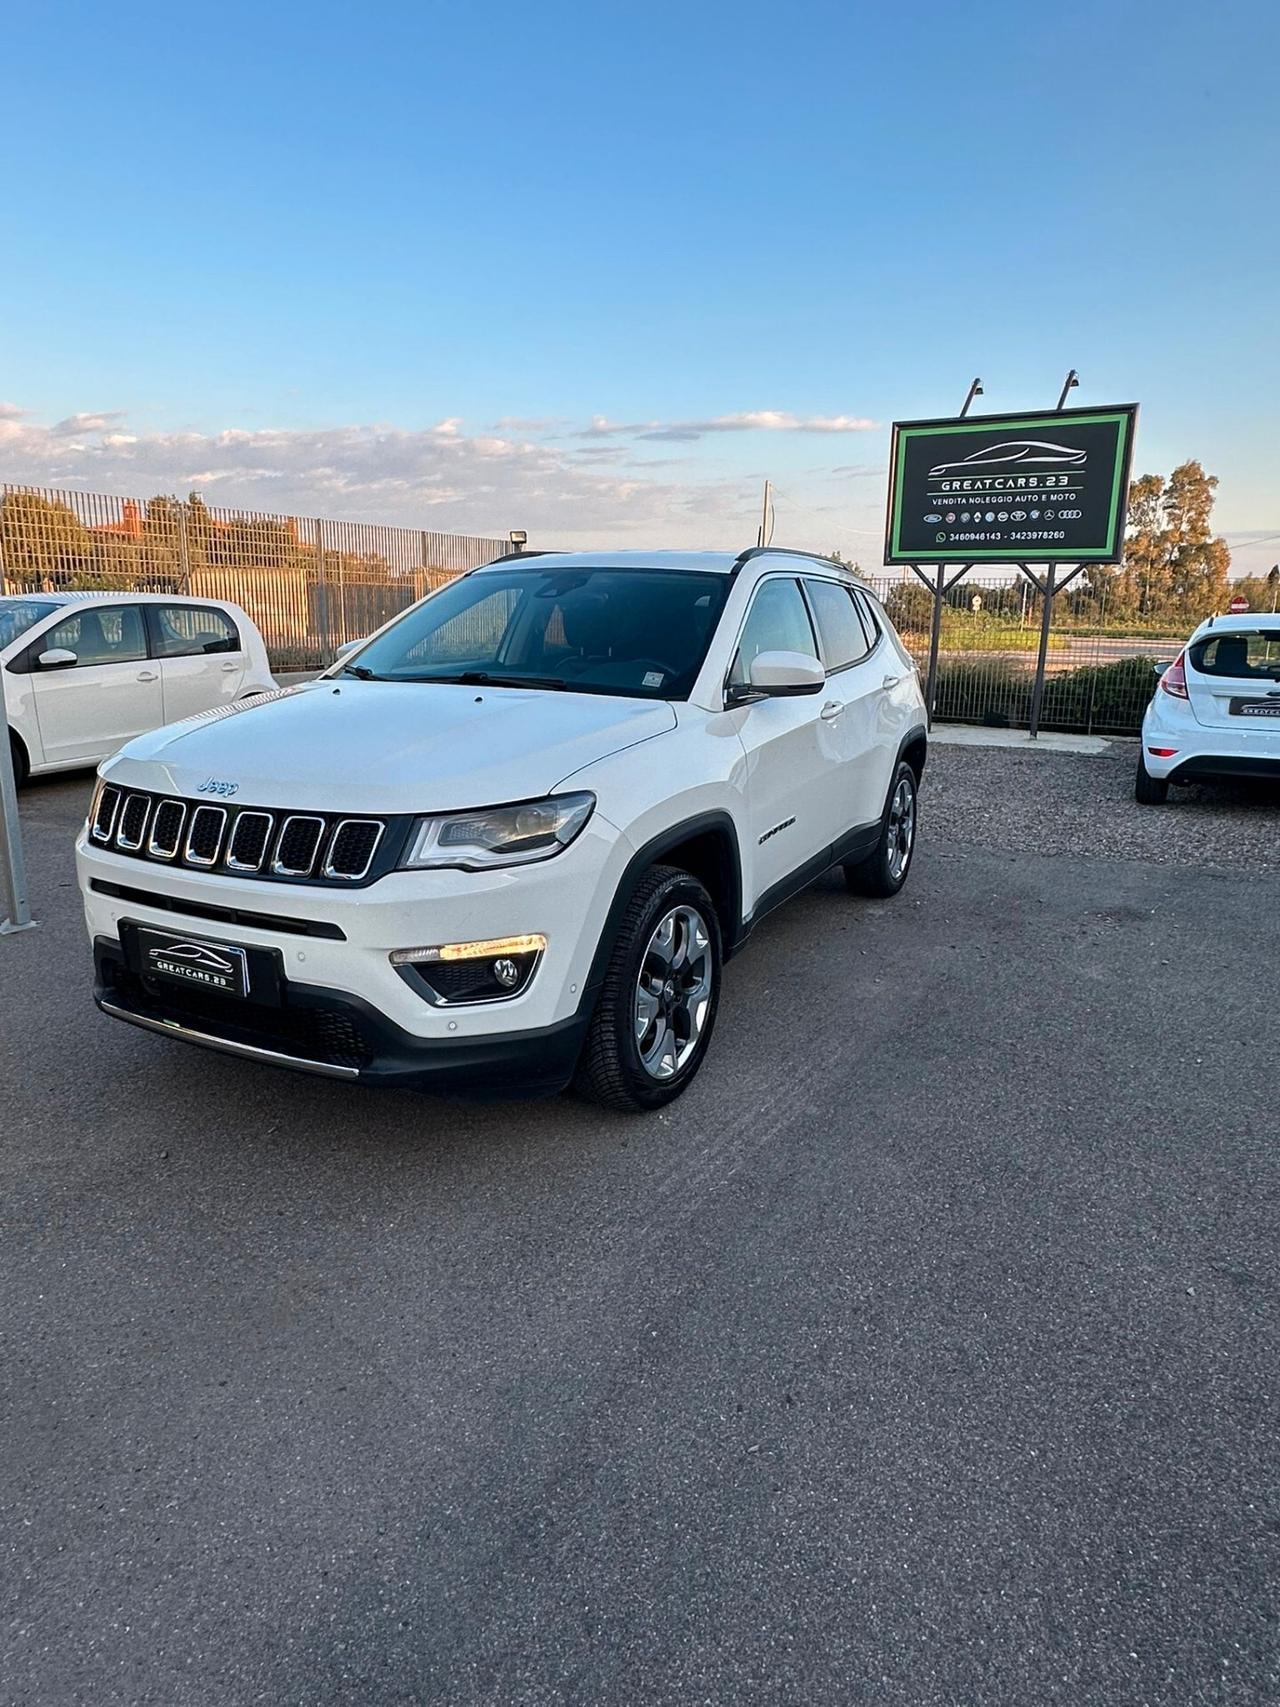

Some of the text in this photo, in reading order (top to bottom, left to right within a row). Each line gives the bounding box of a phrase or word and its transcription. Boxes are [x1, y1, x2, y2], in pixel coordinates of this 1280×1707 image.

[941, 475, 1069, 491] GREATCARS.23
[932, 492, 1076, 506] VENDITA NOLEGGIO AUTO E MOTO
[197, 776, 239, 799] Jeep
[156, 961, 227, 986] GREATCARS.23
